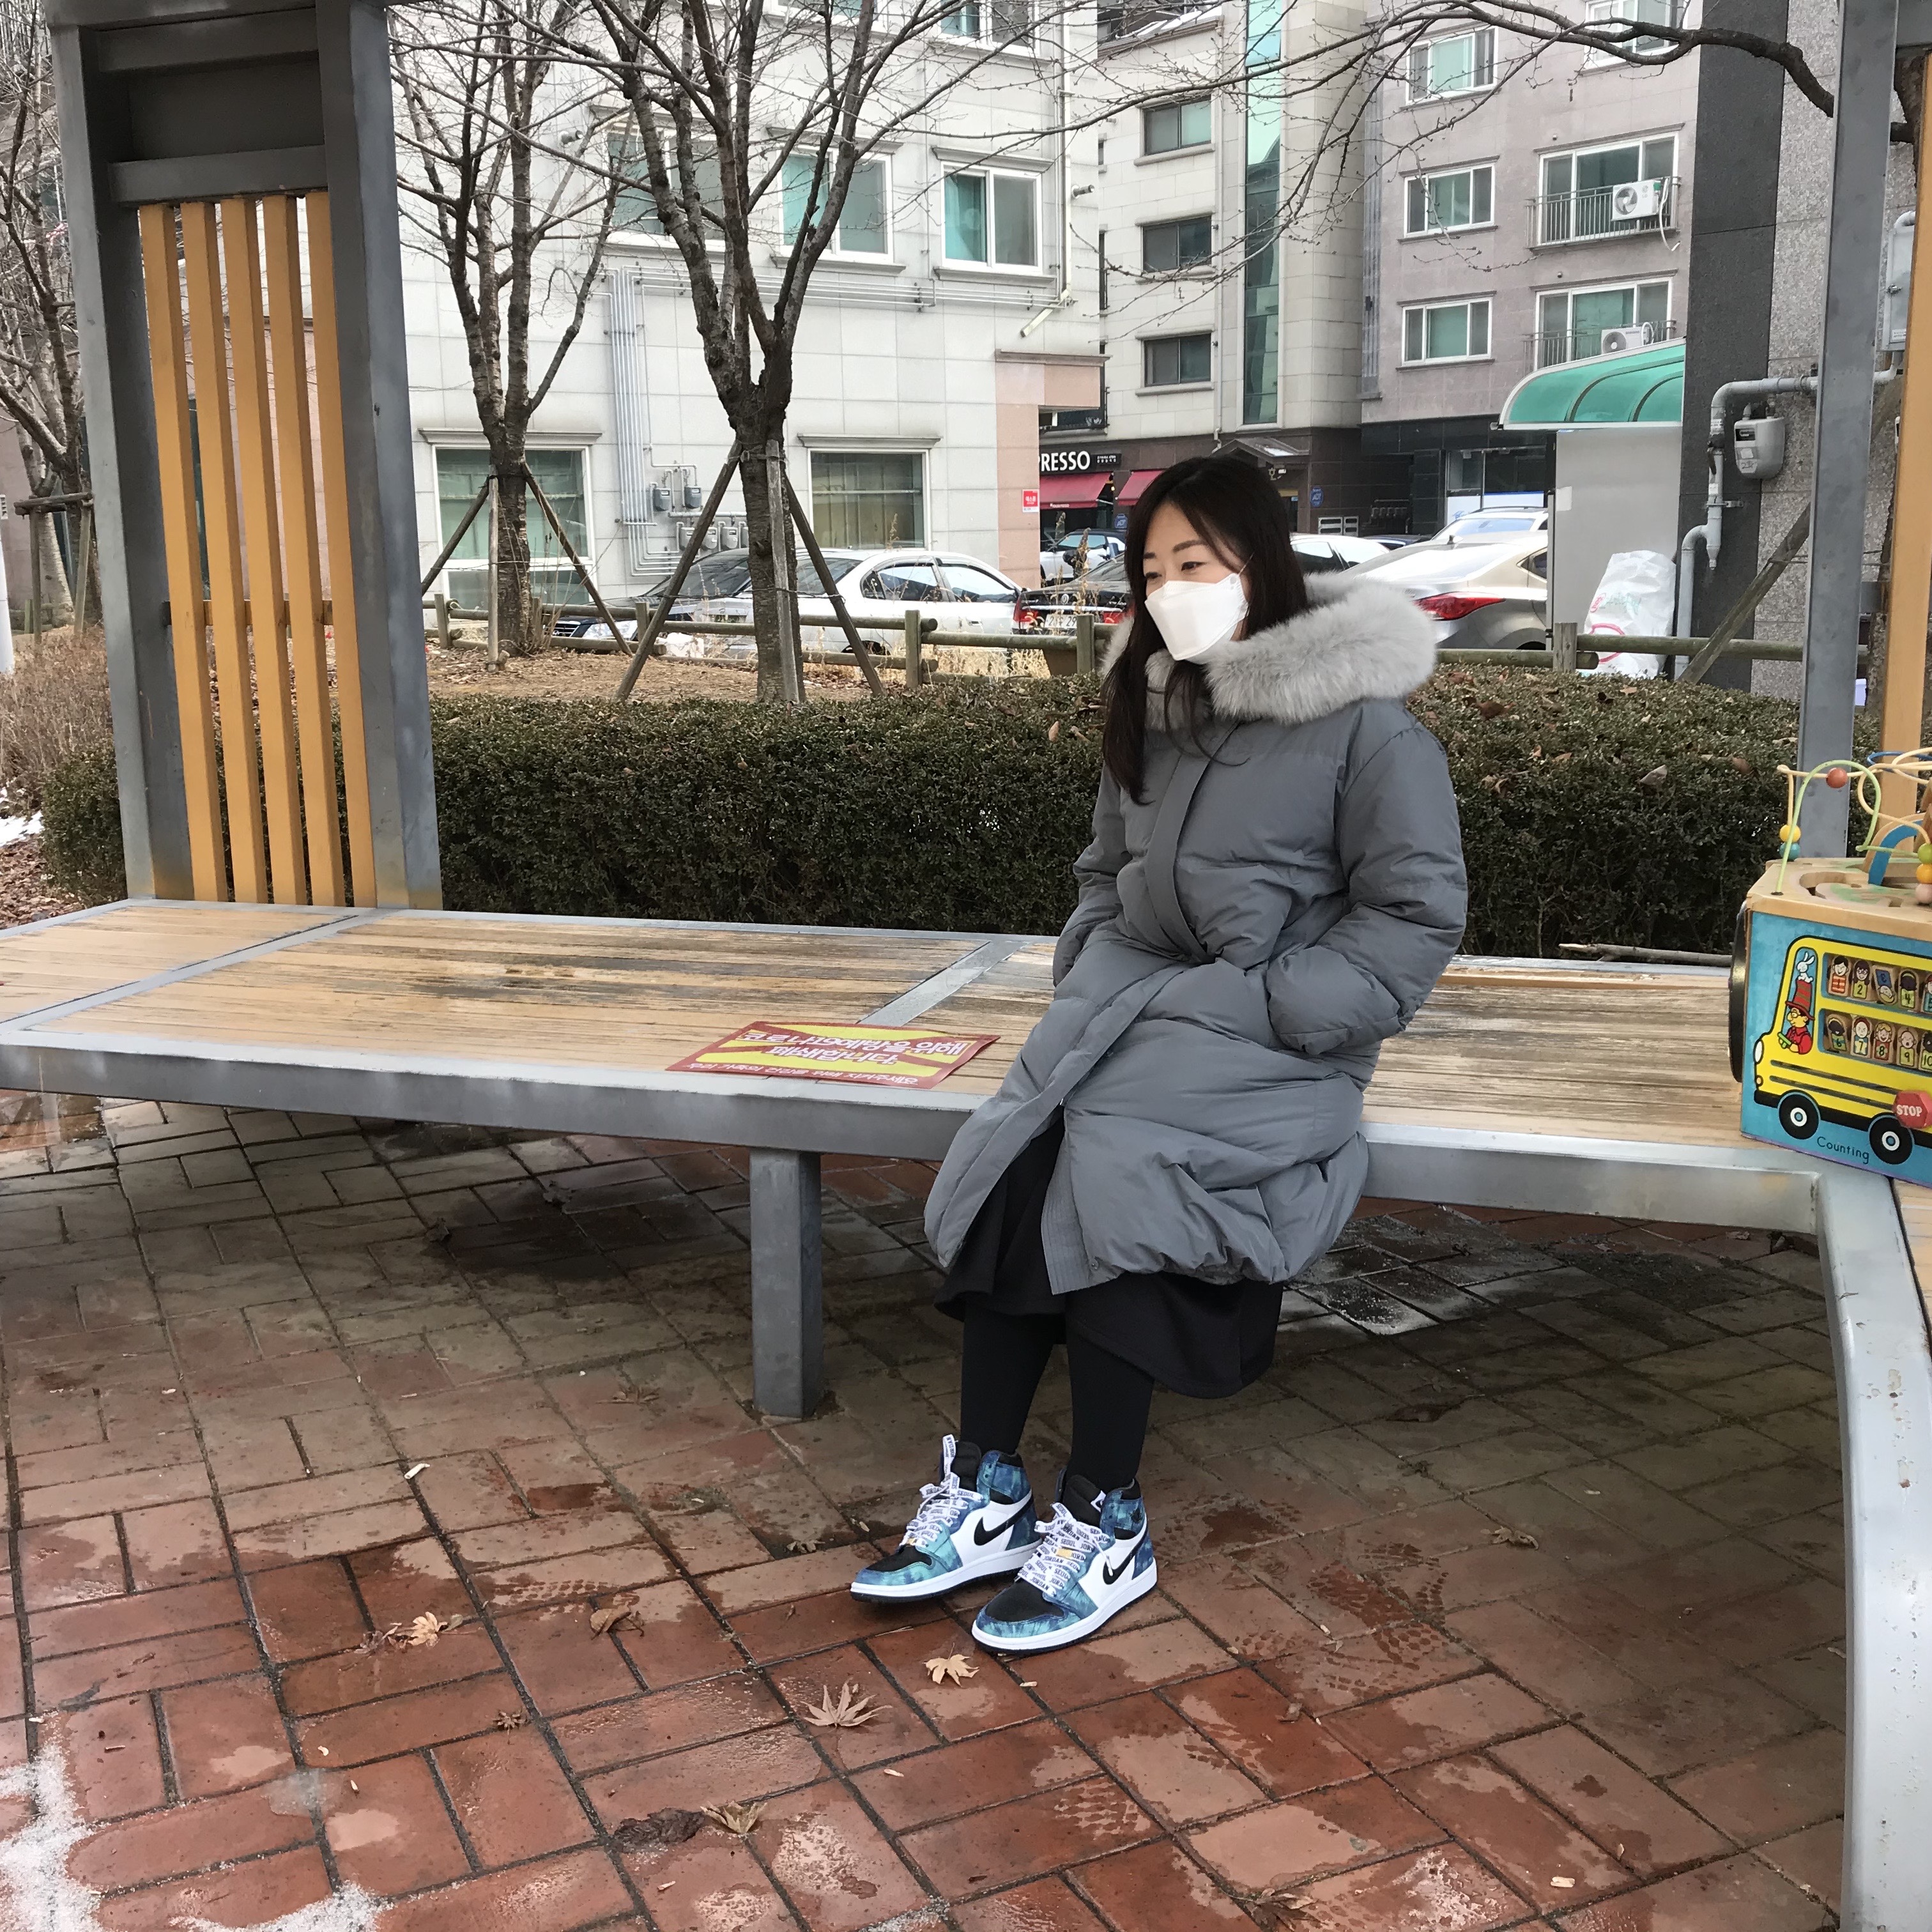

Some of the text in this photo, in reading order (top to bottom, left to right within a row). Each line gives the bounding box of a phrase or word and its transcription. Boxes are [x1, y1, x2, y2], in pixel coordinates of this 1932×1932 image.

[1039, 450, 1091, 471] RESSO
[1066, 615, 1077, 626] 29
[1857, 984, 1863, 995] 2
[1905, 993, 1911, 1004] 4
[766, 1046, 898, 1064] 폐쇄합니다
[910, 1041, 969, 1055] 위해
[1836, 1039, 1842, 1048] 6
[1859, 1040, 1863, 1052] 7
[1879, 1046, 1885, 1056] 8
[1905, 1052, 1910, 1062] 9
[1896, 1104, 1923, 1117] STOP
[1816, 1136, 1869, 1165] Counting
[1061, 1526, 1080, 1541] JORDAN
[1061, 1538, 1076, 1547] SEOUL
[1043, 1555, 1064, 1564] JORDAN
[1071, 1552, 1085, 1561] JORD
[1035, 1560, 1048, 1574] SEOUL
[1031, 1577, 1050, 1591] JORDAN
